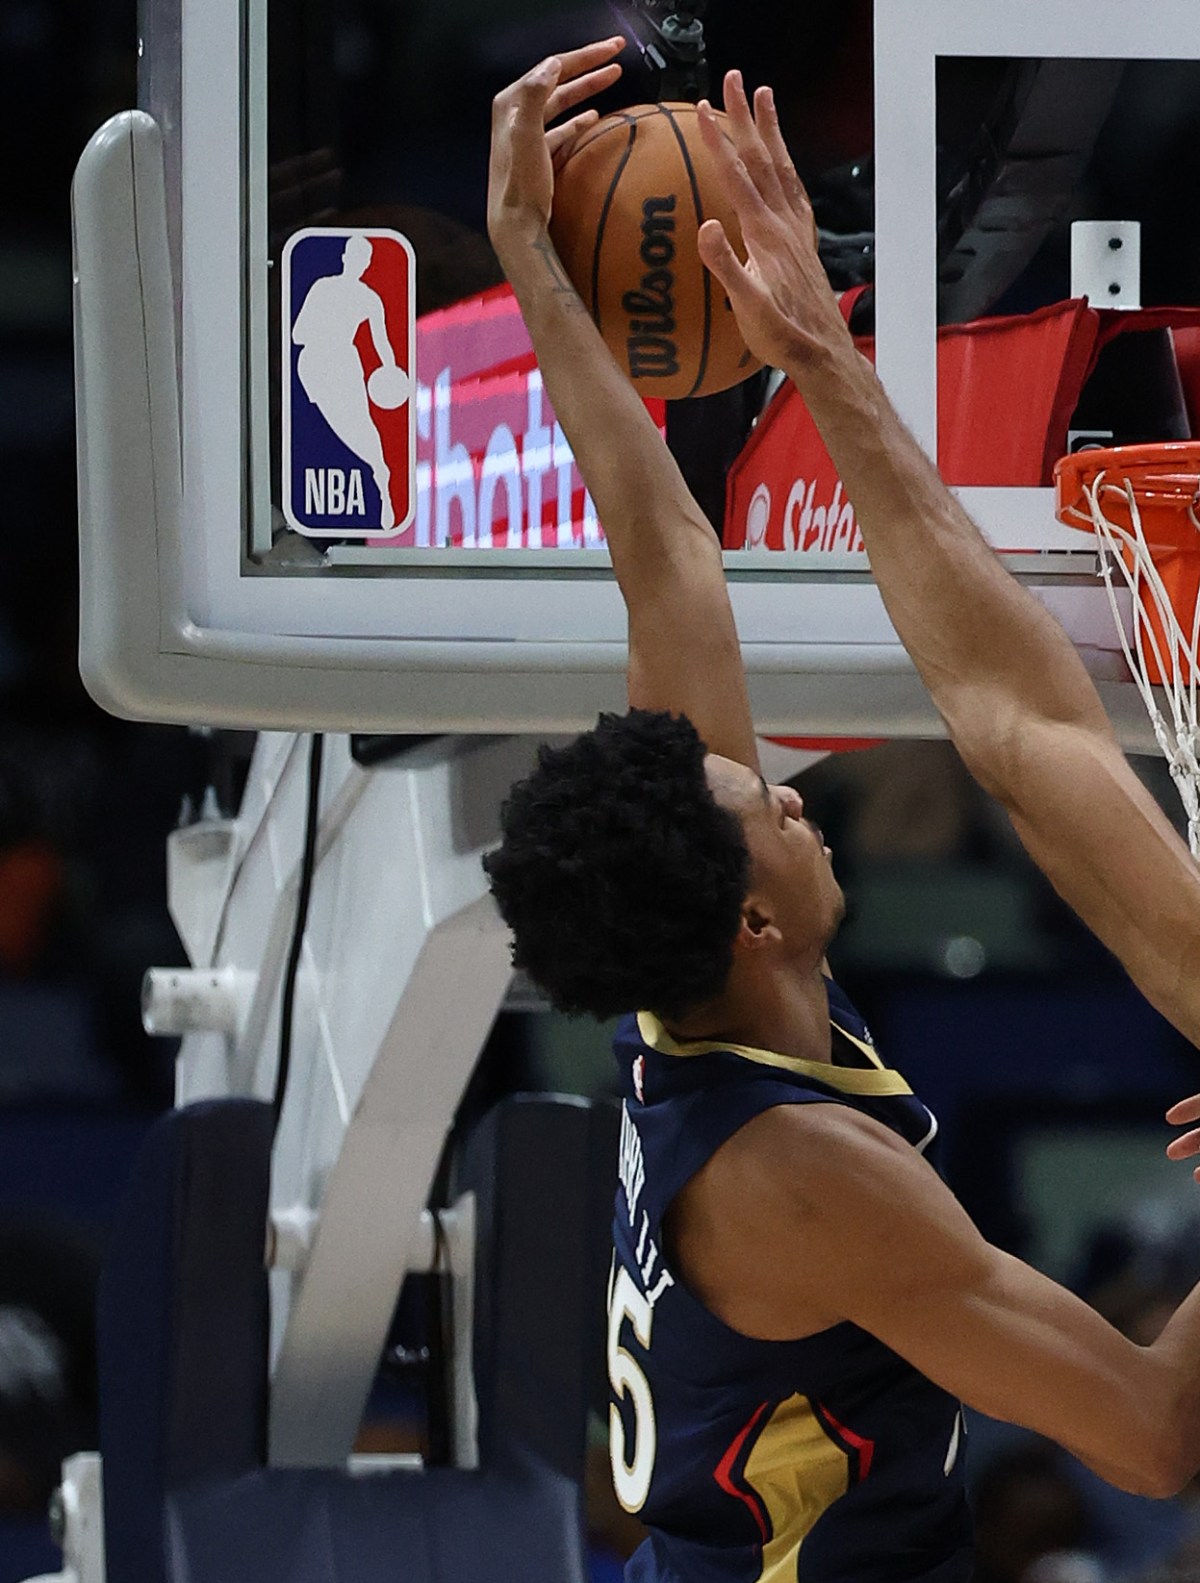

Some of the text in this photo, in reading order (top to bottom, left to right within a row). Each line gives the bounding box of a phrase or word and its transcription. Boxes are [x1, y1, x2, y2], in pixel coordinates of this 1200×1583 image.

[622, 194, 680, 378] Wilson
[305, 468, 366, 515] NBA
[606, 1246, 657, 1514] 5
